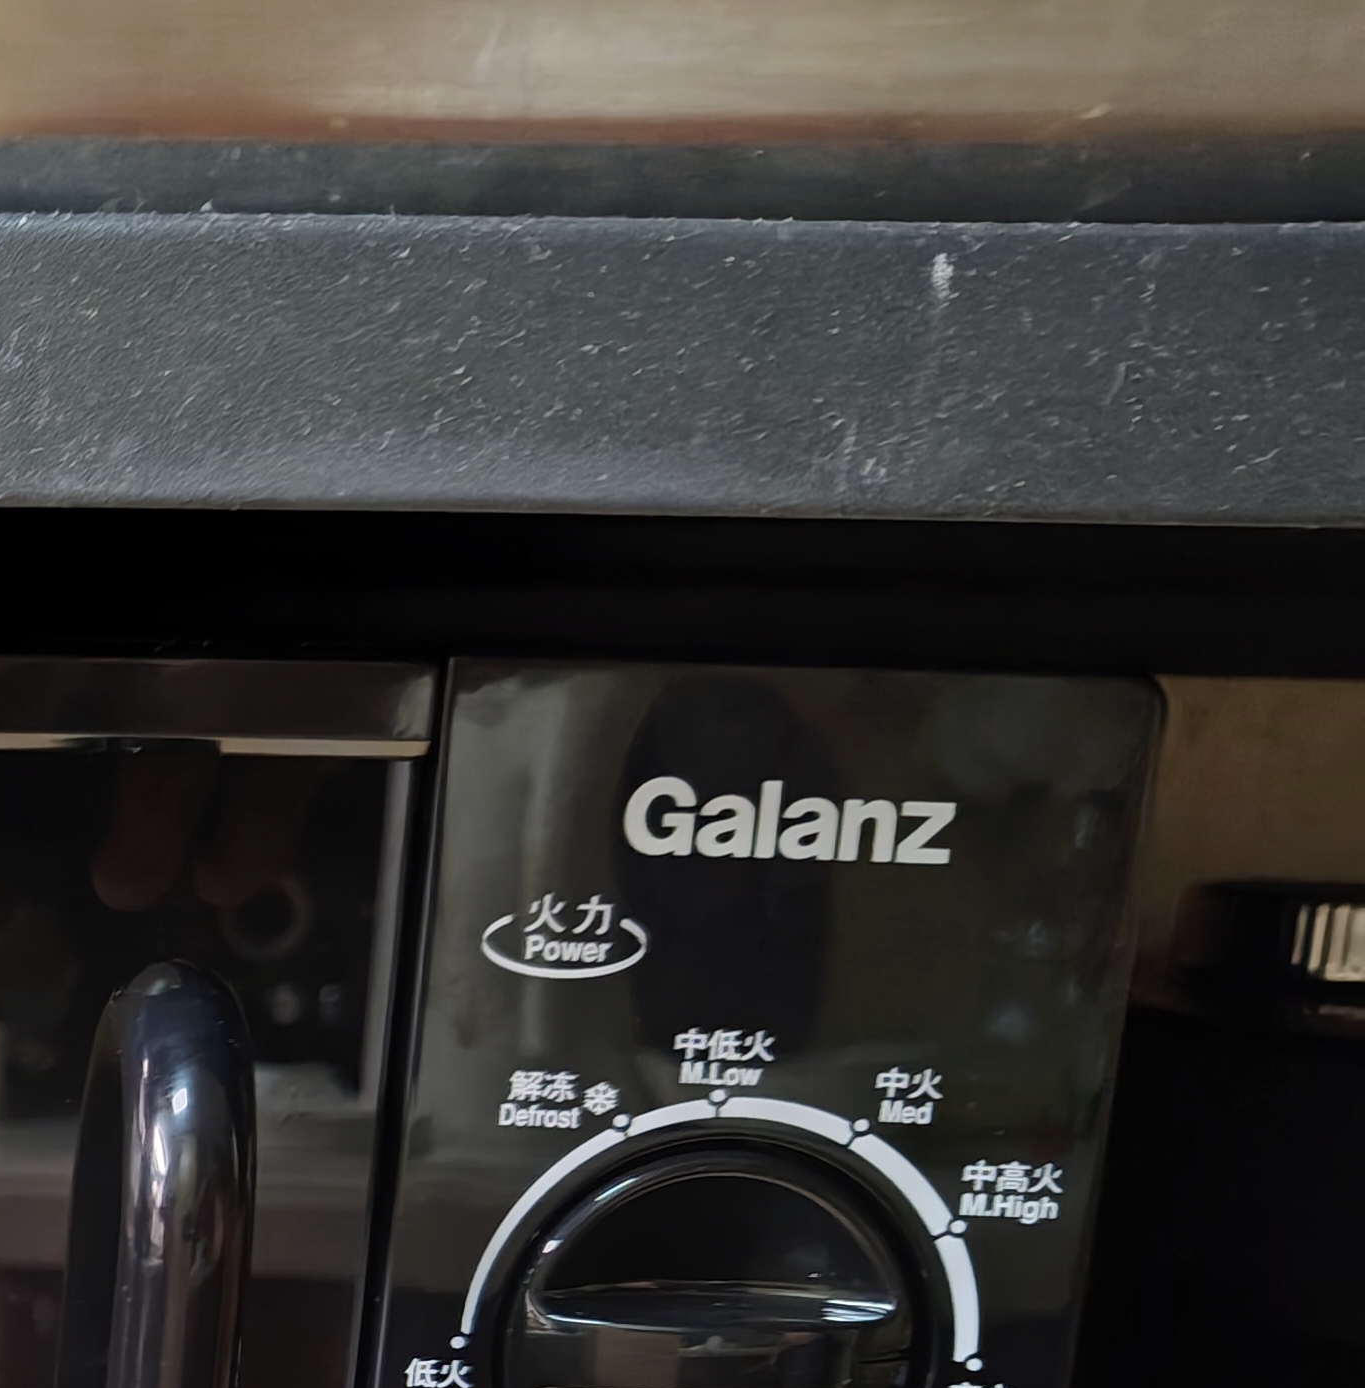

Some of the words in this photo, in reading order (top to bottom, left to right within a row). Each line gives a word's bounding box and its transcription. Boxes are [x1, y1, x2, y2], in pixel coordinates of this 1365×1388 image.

[624, 776, 957, 865] Galanz
[525, 893, 613, 935] 火力
[524, 936, 610, 963] Power
[673, 1028, 775, 1062] 中低火
[508, 1070, 577, 1103] 解冻
[679, 1062, 762, 1087] M.Low
[875, 1068, 943, 1101] 中火
[498, 1104, 581, 1130] Defrost
[878, 1100, 933, 1126] Med
[961, 1161, 1063, 1193] 中高火
[960, 1193, 1059, 1222] M.High
